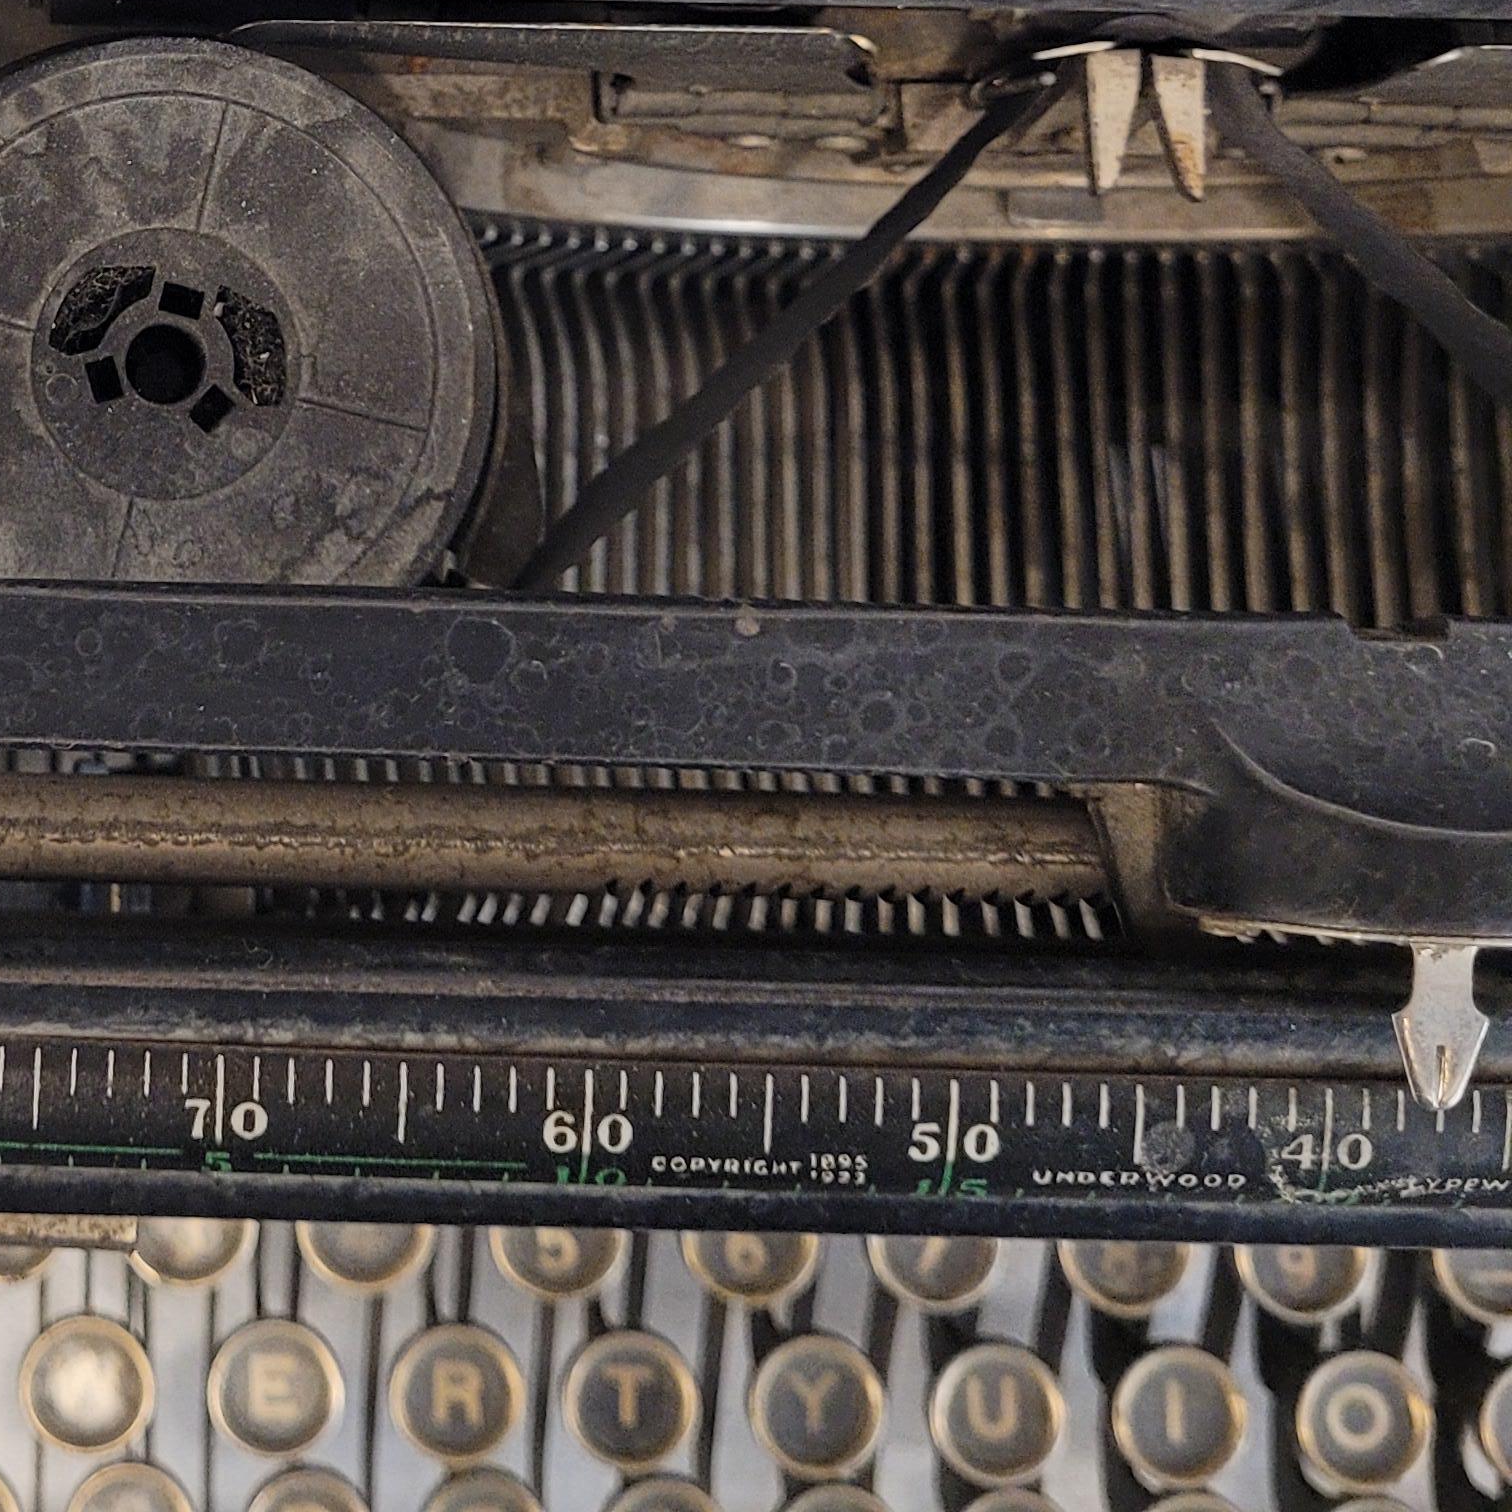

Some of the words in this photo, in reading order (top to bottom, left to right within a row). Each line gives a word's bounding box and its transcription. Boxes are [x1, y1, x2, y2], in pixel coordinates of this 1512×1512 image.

[184, 1098, 268, 1140] 70
[543, 1110, 633, 1154] 60
[908, 1122, 1000, 1163] 50
[651, 1155, 804, 1176] COPYRIGHT
[1032, 1169, 1248, 1189] UNDERWOOD
[1281, 1133, 1373, 1170] 40
[248, 1350, 300, 1423] E
[431, 1357, 484, 1427] R
[596, 1363, 656, 1429] T
[792, 1369, 840, 1435] Y
[966, 1373, 1019, 1441] U
[1325, 1384, 1391, 1453] O
